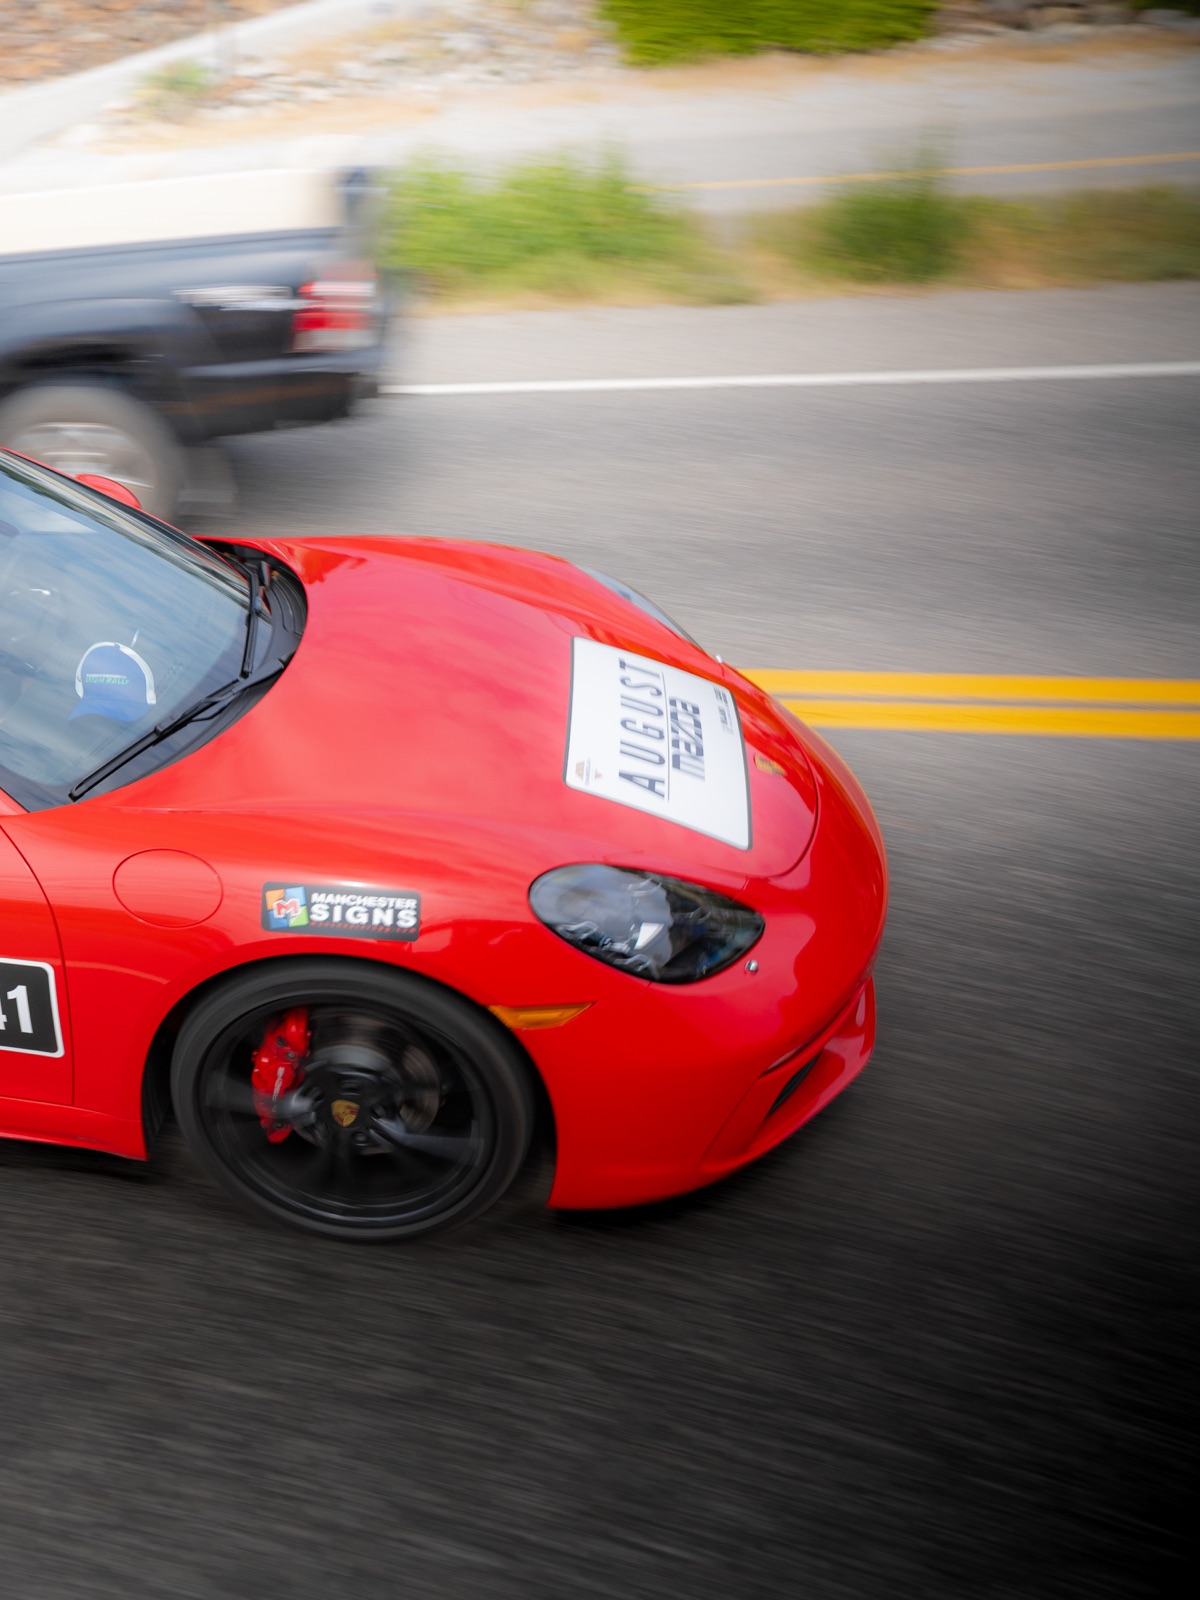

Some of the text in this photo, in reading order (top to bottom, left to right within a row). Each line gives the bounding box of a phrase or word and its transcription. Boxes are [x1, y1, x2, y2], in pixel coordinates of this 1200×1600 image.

[618, 657, 666, 799] AUGUST
[310, 892, 418, 910] MANCHESTER
[309, 903, 418, 928] SIGNS
